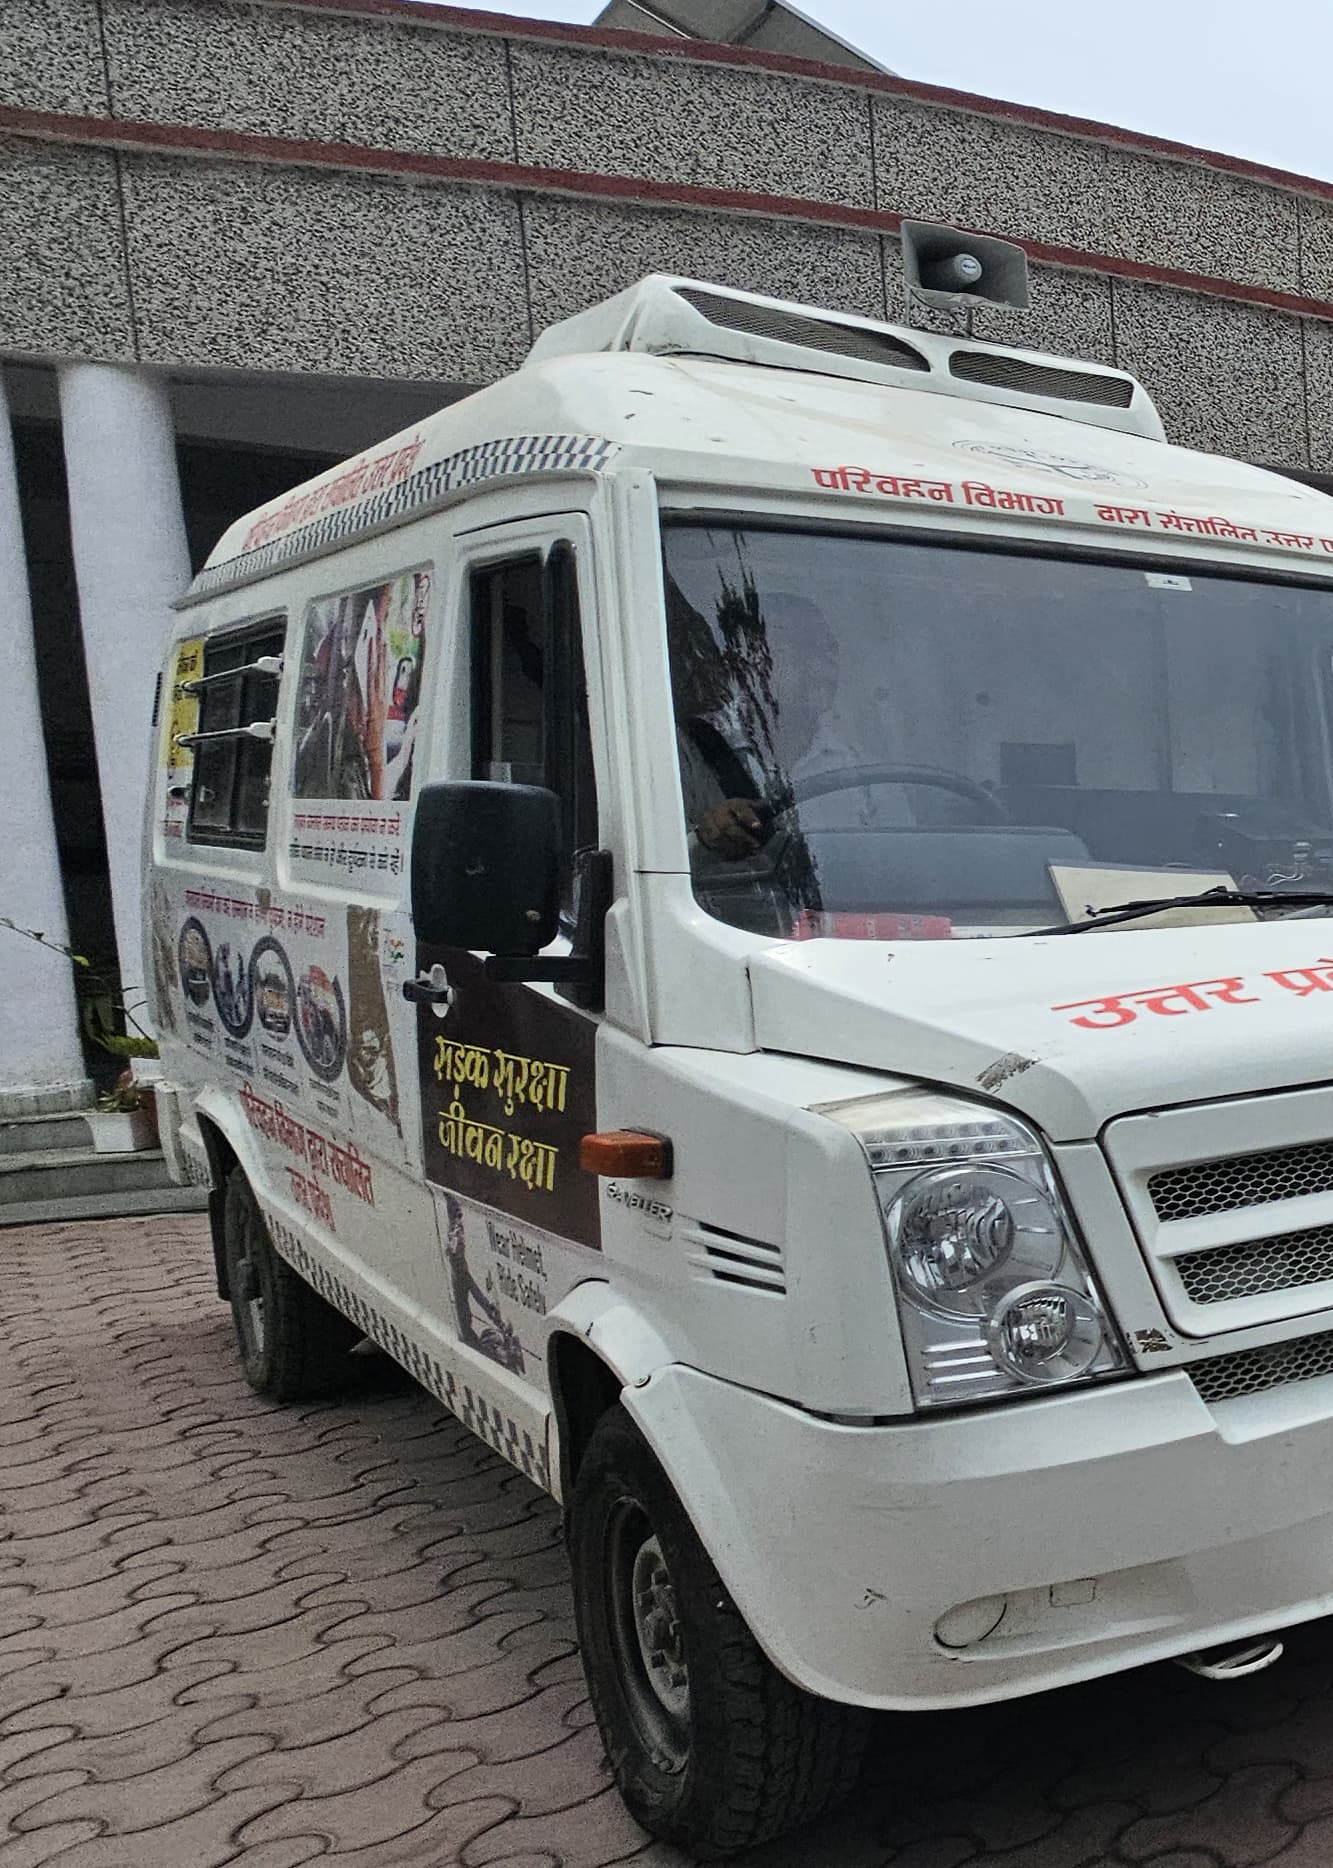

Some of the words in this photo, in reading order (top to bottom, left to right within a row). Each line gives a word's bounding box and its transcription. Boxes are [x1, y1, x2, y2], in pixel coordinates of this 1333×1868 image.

[811, 465, 954, 503] परिवहन
[961, 480, 1064, 516] विभाग
[1050, 977, 1261, 1029] उत्तर
[434, 1035, 491, 1100] सड़क
[493, 1049, 571, 1116] सुरक्षा
[439, 1101, 505, 1171] जीवन
[507, 1134, 559, 1191] रक्षा
